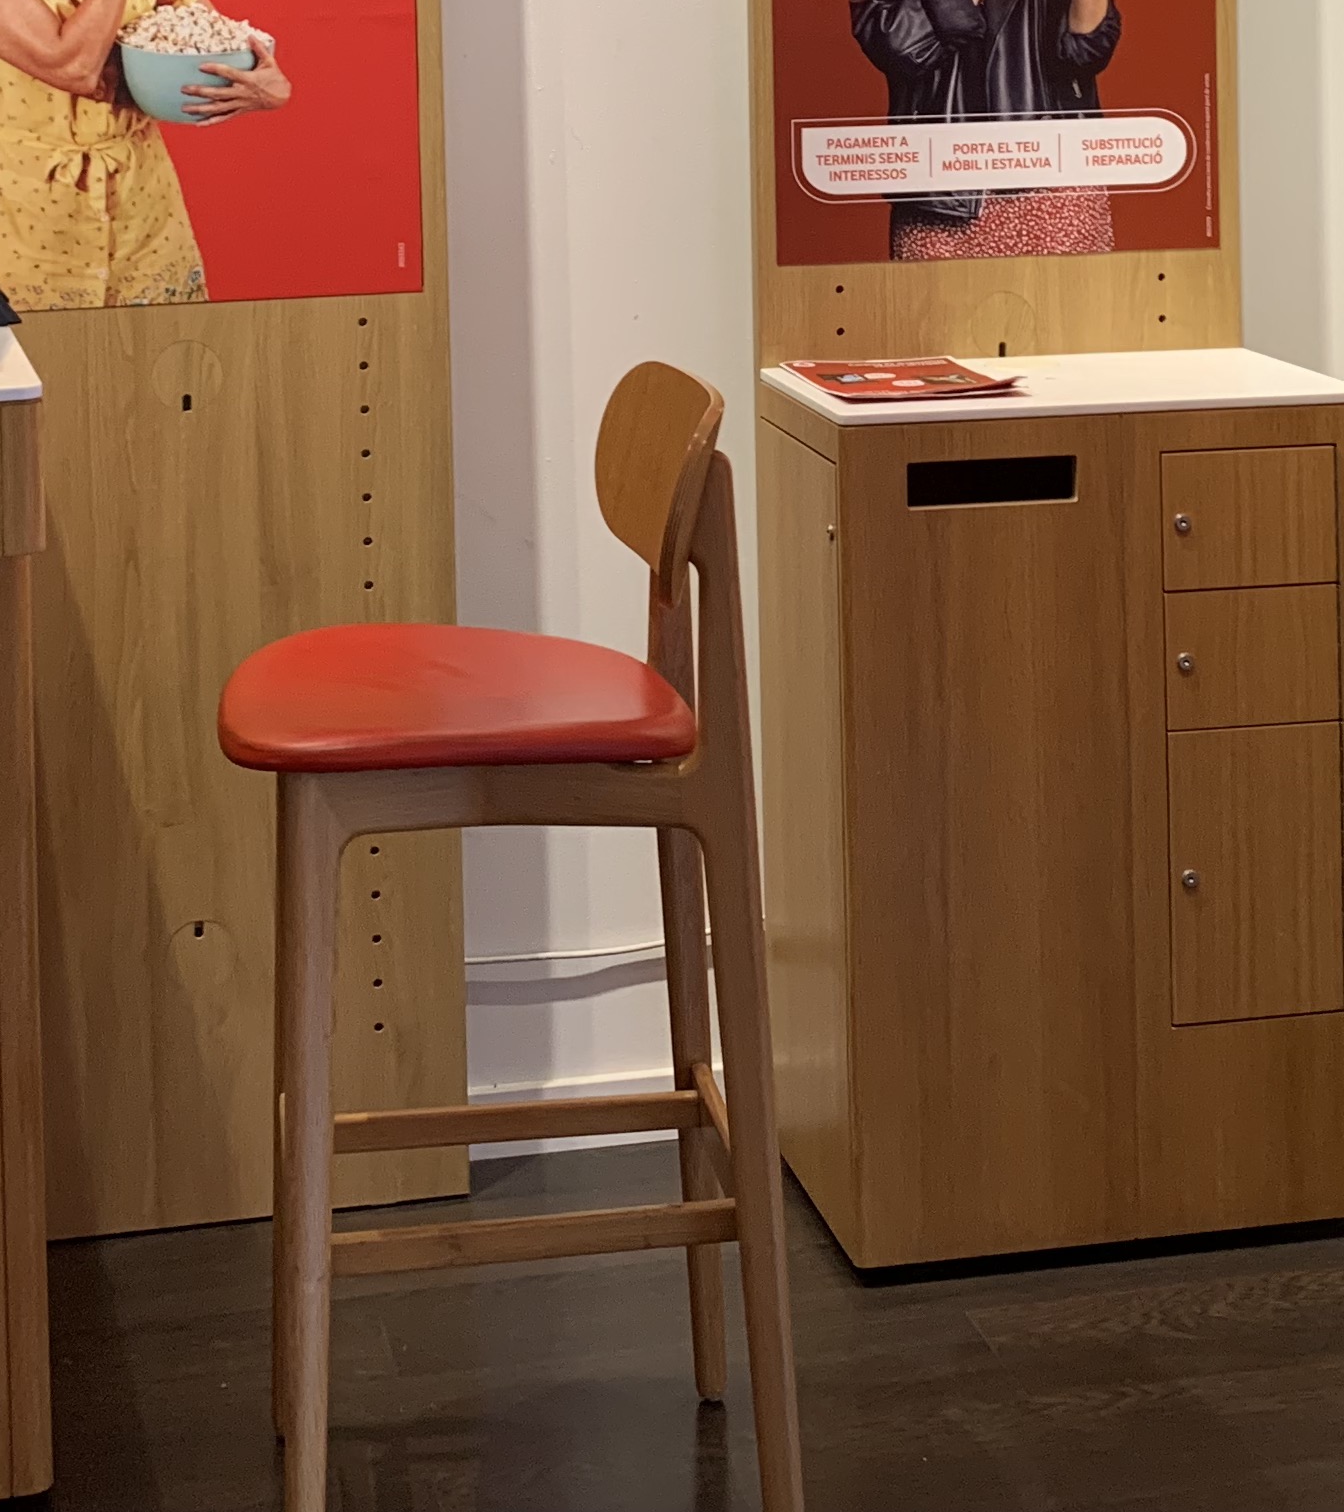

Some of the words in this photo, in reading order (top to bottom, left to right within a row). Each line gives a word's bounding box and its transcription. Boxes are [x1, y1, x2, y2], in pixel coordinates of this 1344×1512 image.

[827, 137, 897, 149] PAGAMENT
[900, 136, 909, 148] A
[953, 143, 994, 155] PORTA
[998, 142, 1013, 153] EL
[1016, 141, 1040, 153] TEU
[1082, 134, 1163, 151] SUBSTITUCIÓ
[816, 154, 876, 166] TERMINIS
[878, 152, 920, 164] SENSE
[942, 157, 982, 171] MÒBIL
[992, 157, 1052, 170] ESTALVIA
[1092, 152, 1163, 167] REPARACIÓ
[829, 169, 907, 182] INTERESSOS
